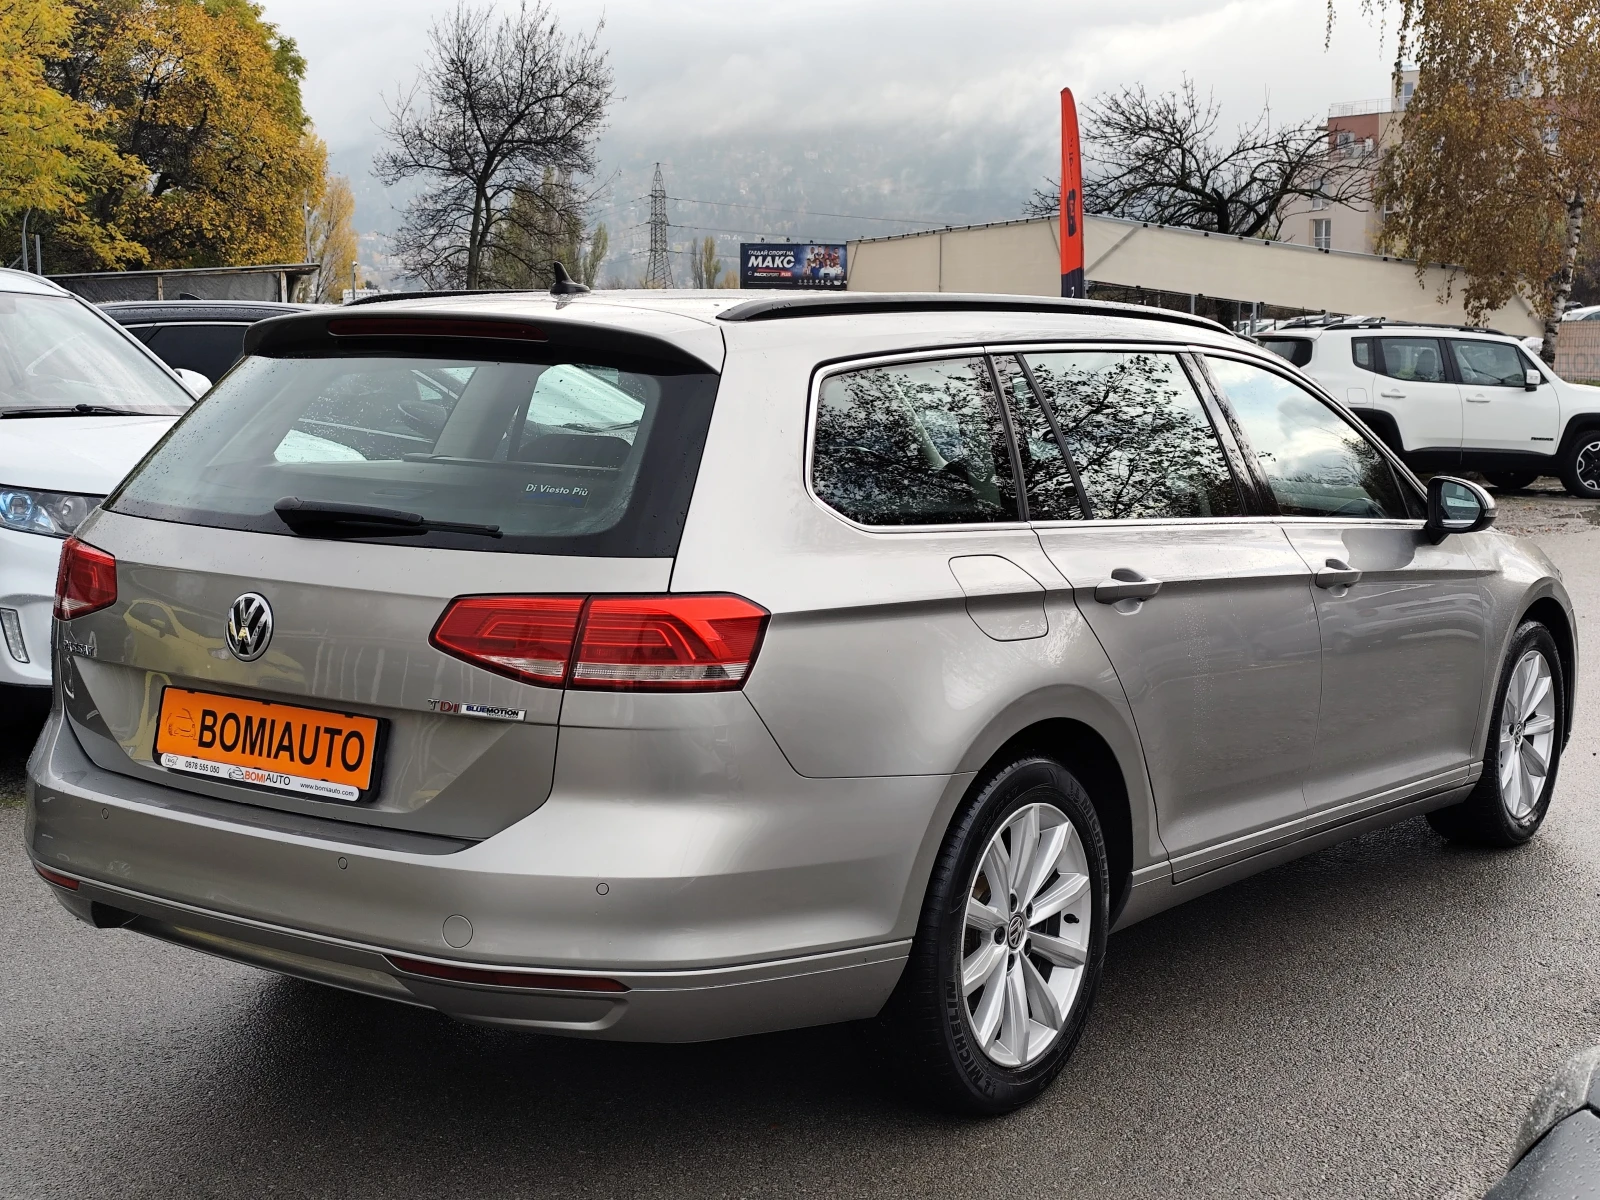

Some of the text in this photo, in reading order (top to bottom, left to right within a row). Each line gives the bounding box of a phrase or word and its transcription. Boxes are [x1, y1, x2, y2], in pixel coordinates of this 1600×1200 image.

[748, 256, 795, 268] МАКС
[525, 483, 538, 492] Di
[427, 698, 460, 713] TDI
[466, 704, 519, 716] BLUEMOTION
[197, 708, 365, 773] BOMIAUTO
[185, 760, 220, 774] 0878 555 050
[244, 770, 291, 786] BOMIAUTO
[300, 782, 355, 797] www.bomiauto.com
